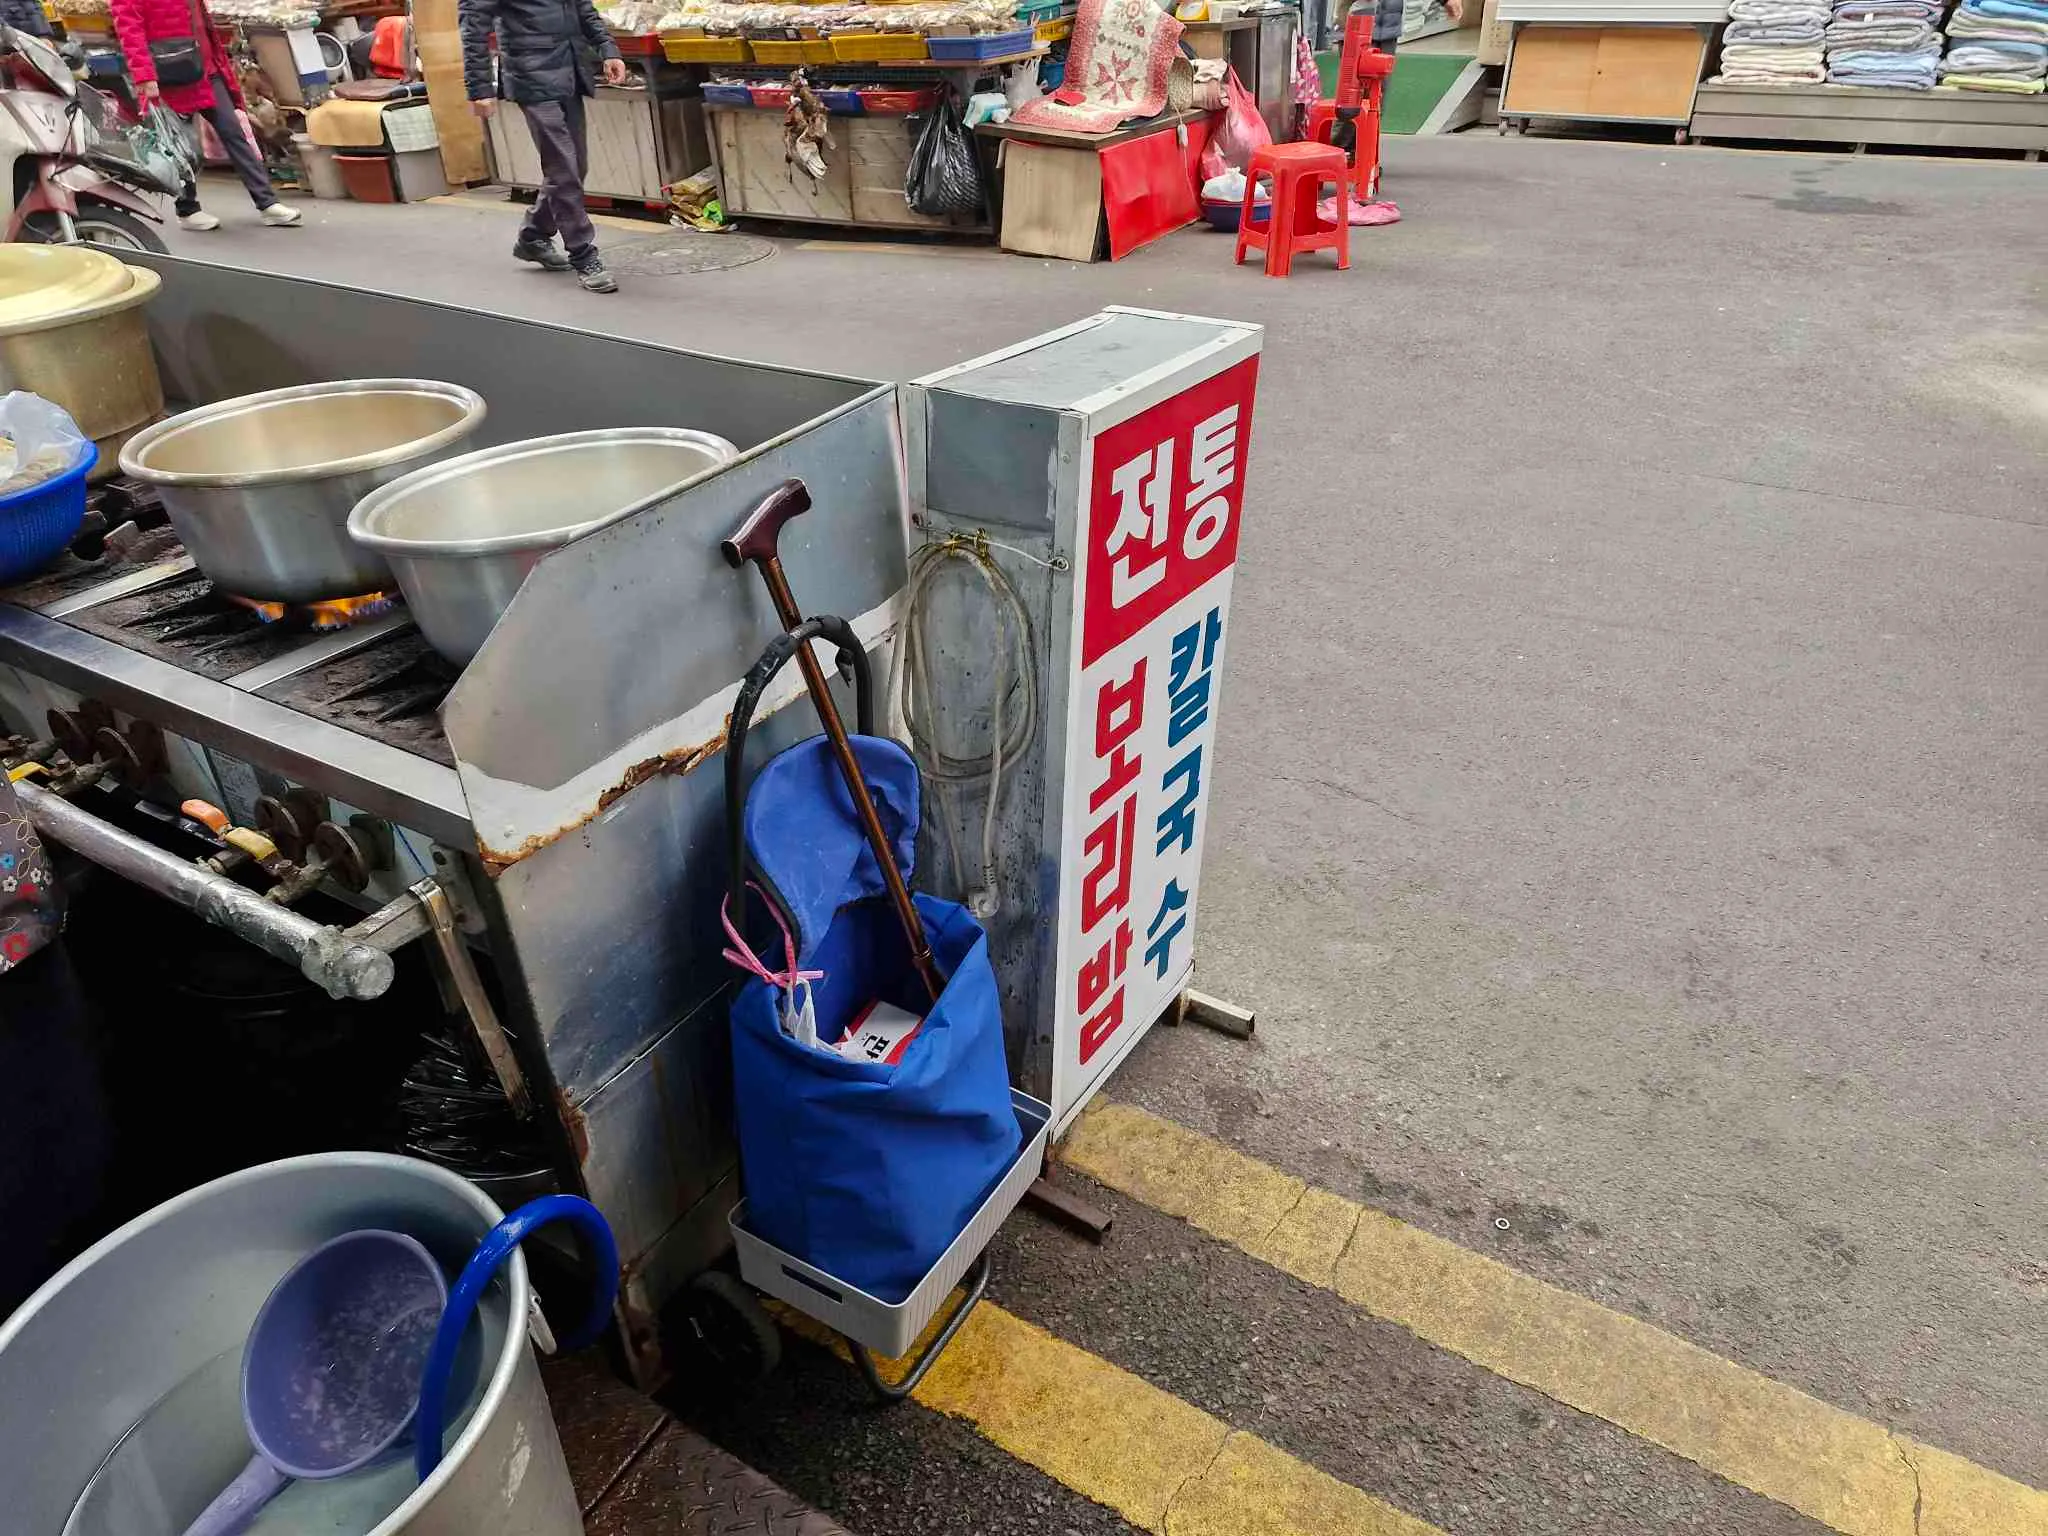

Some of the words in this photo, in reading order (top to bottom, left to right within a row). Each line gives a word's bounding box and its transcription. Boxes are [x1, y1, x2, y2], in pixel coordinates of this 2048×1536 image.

[1106, 404, 1239, 609] 전통
[1078, 656, 1147, 1065] 보리밥
[1144, 606, 1222, 982] 칼국수
